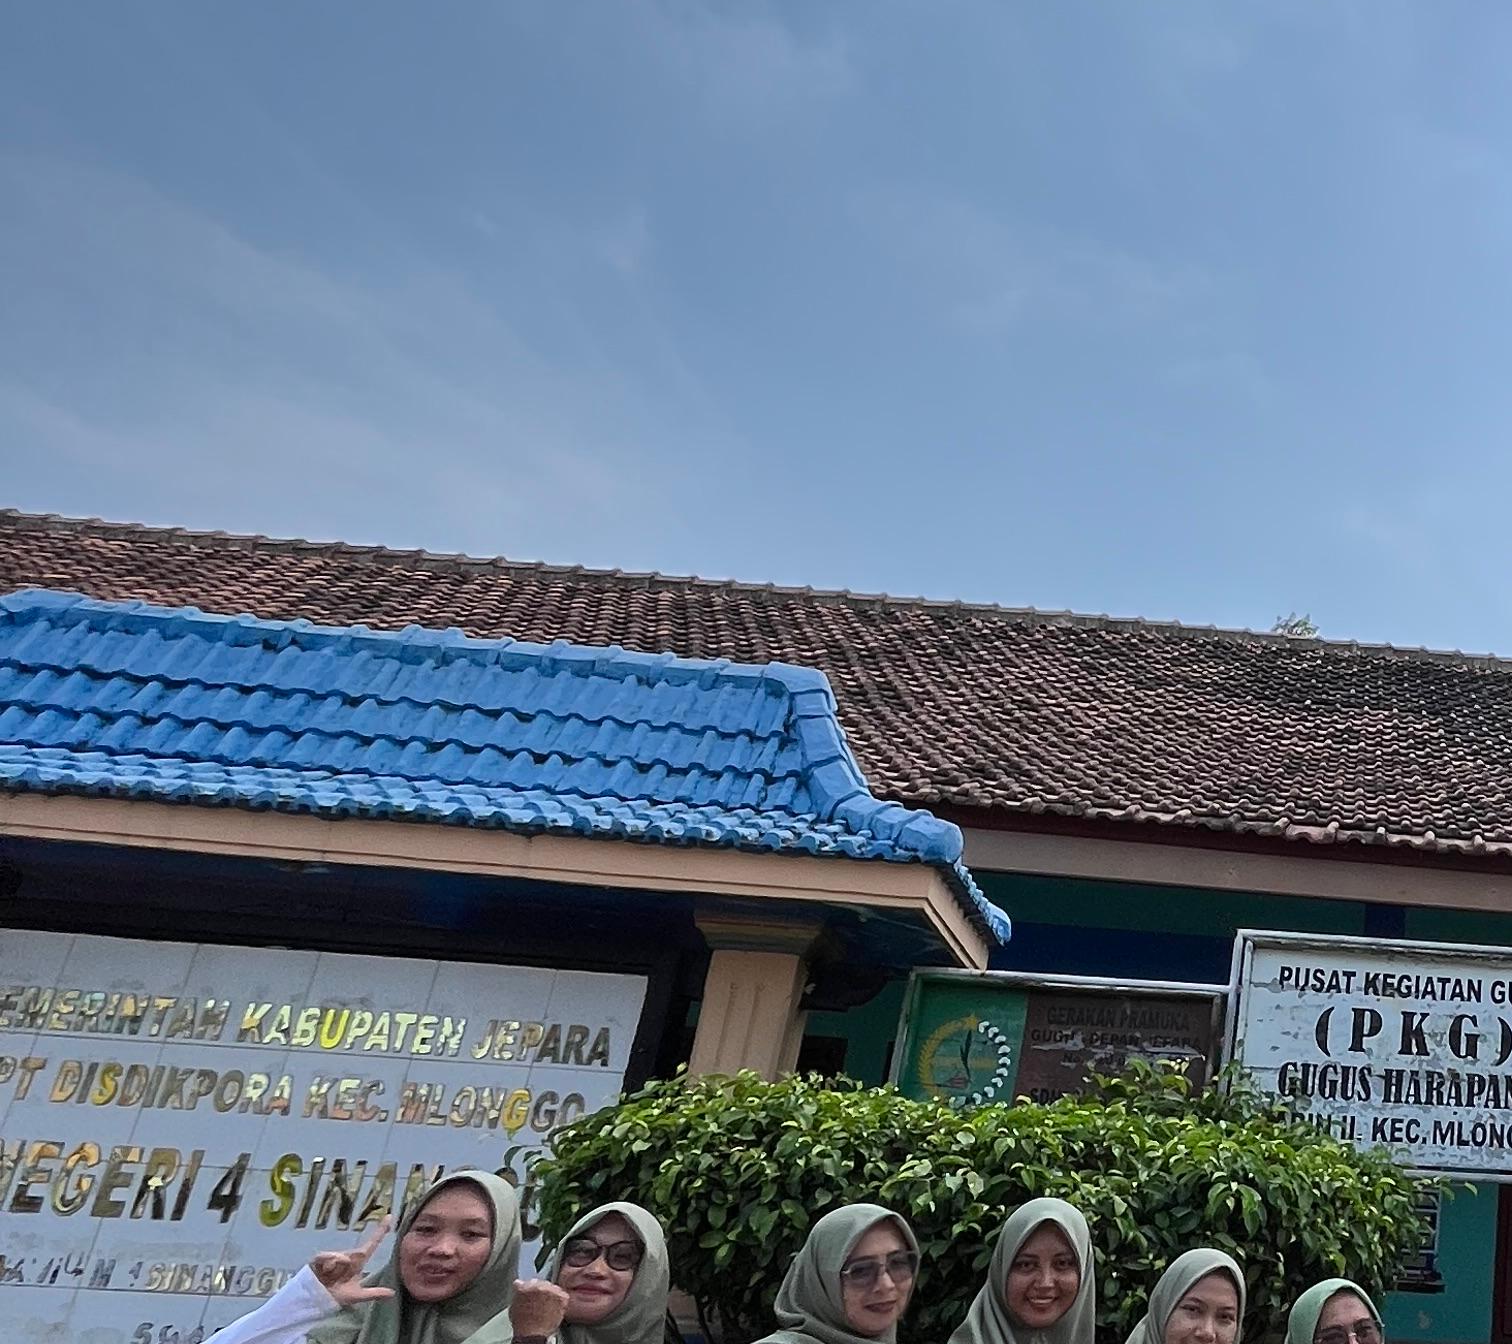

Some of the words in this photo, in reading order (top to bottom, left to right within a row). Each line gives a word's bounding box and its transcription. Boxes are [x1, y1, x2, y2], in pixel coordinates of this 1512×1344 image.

[1279, 966, 1356, 994] PUSAT
[1364, 972, 1482, 1003] KEGIATAN
[237, 1001, 467, 1057] KABUPATEN
[472, 1019, 611, 1066] JEPARA
[1047, 1006, 1116, 1028] GERAKAN
[1120, 1007, 1190, 1031] PRAMUKA
[50, 1059, 294, 1116] DISDIKPORA
[303, 1073, 389, 1122] KEC.
[395, 1080, 587, 1133] MLONGGO
[1278, 1061, 1372, 1102] GUGUS
[1371, 1116, 1427, 1145] KEC.
[207, 1152, 252, 1224] 4
